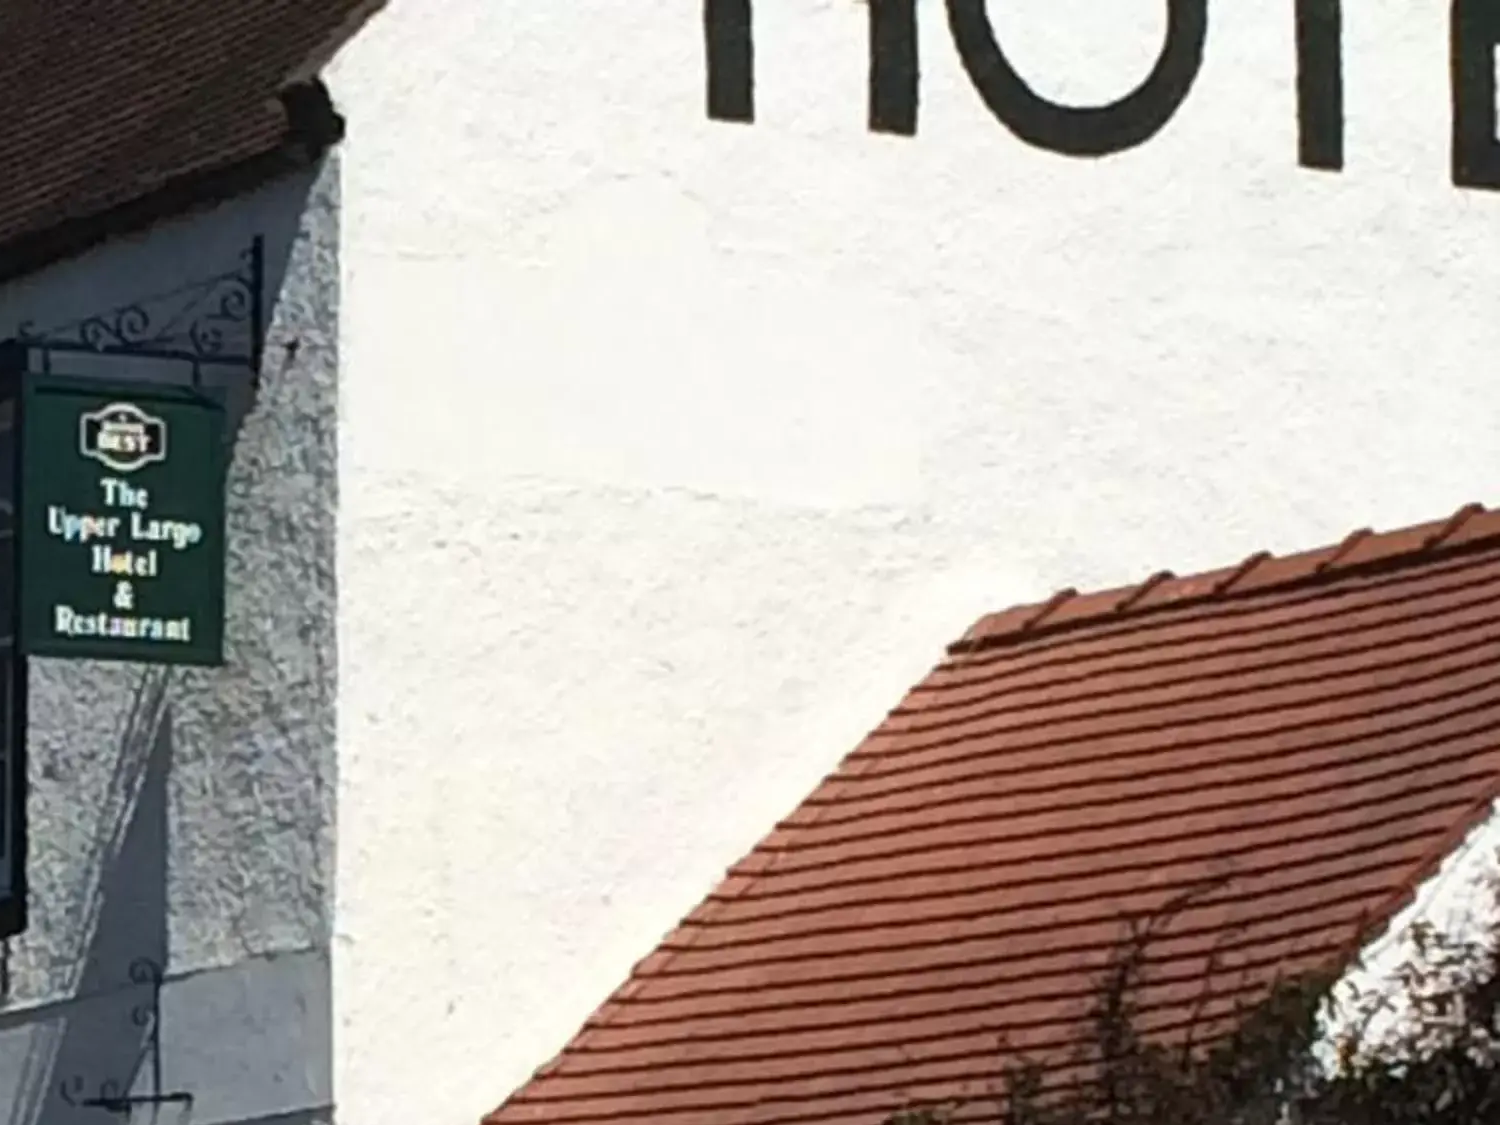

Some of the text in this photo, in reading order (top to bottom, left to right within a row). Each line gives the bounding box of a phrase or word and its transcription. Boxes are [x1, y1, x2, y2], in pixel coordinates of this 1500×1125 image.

[101, 478, 148, 508] The
[48, 505, 202, 549] Upper Largo
[92, 546, 157, 576] Hotel
[113, 581, 133, 610] &
[55, 605, 190, 641] Restaurant
